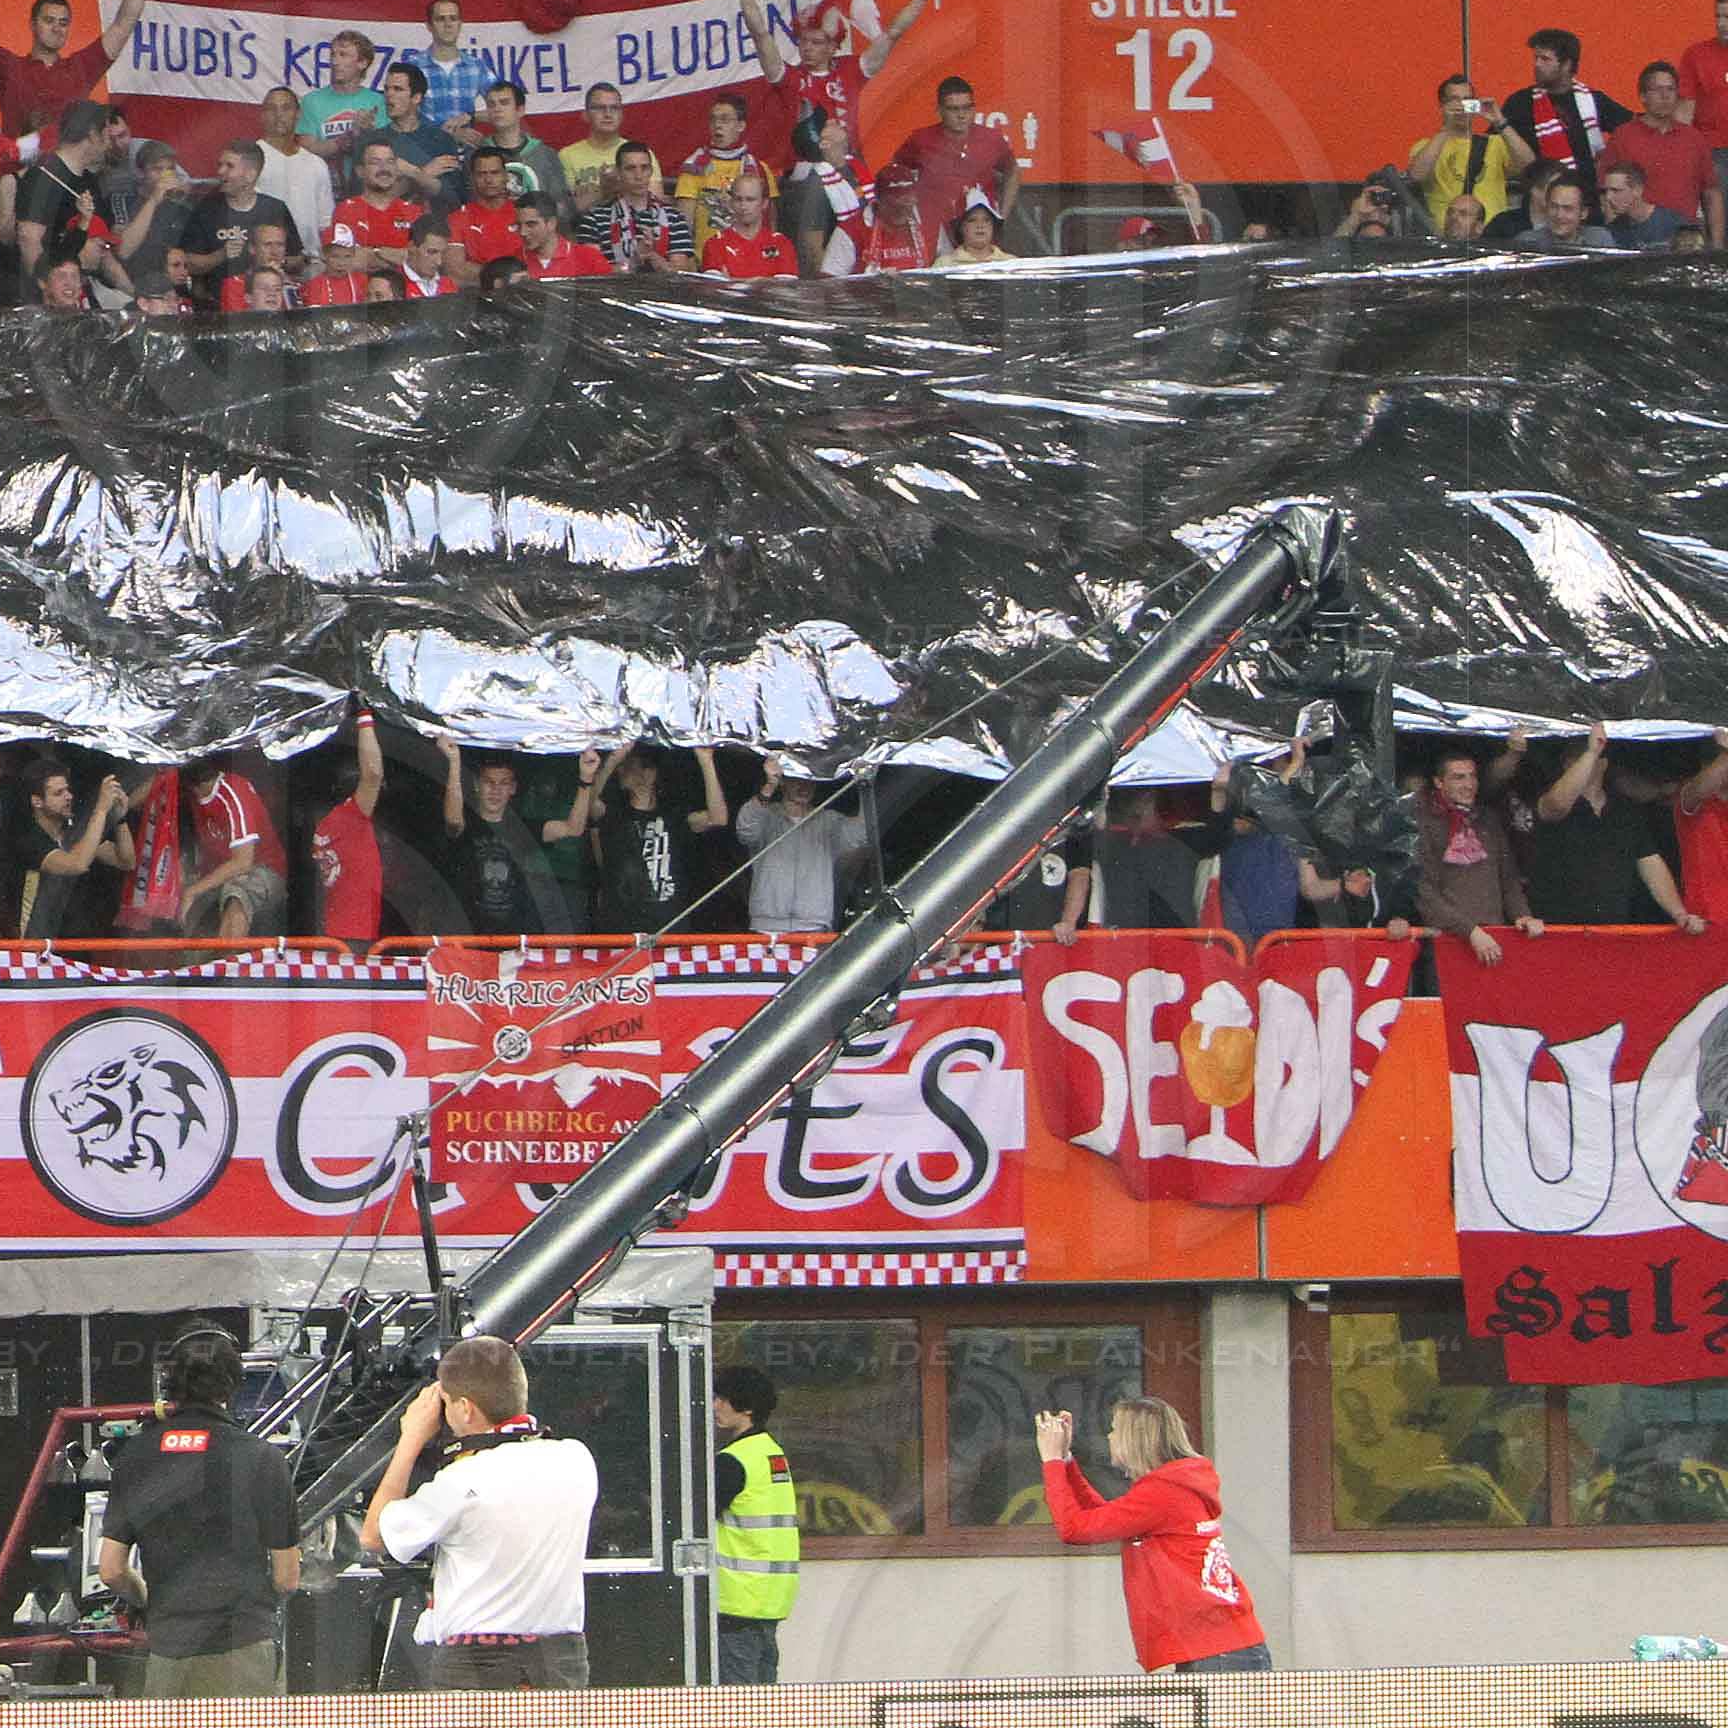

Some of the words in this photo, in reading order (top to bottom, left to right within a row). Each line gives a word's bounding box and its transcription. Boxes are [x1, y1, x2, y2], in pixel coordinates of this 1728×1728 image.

[1115, 27, 1214, 112] 12
[435, 976, 651, 1005] HURRICANES
[445, 1111, 607, 1134] PUCHBERG
[165, 1433, 208, 1450] ORF
